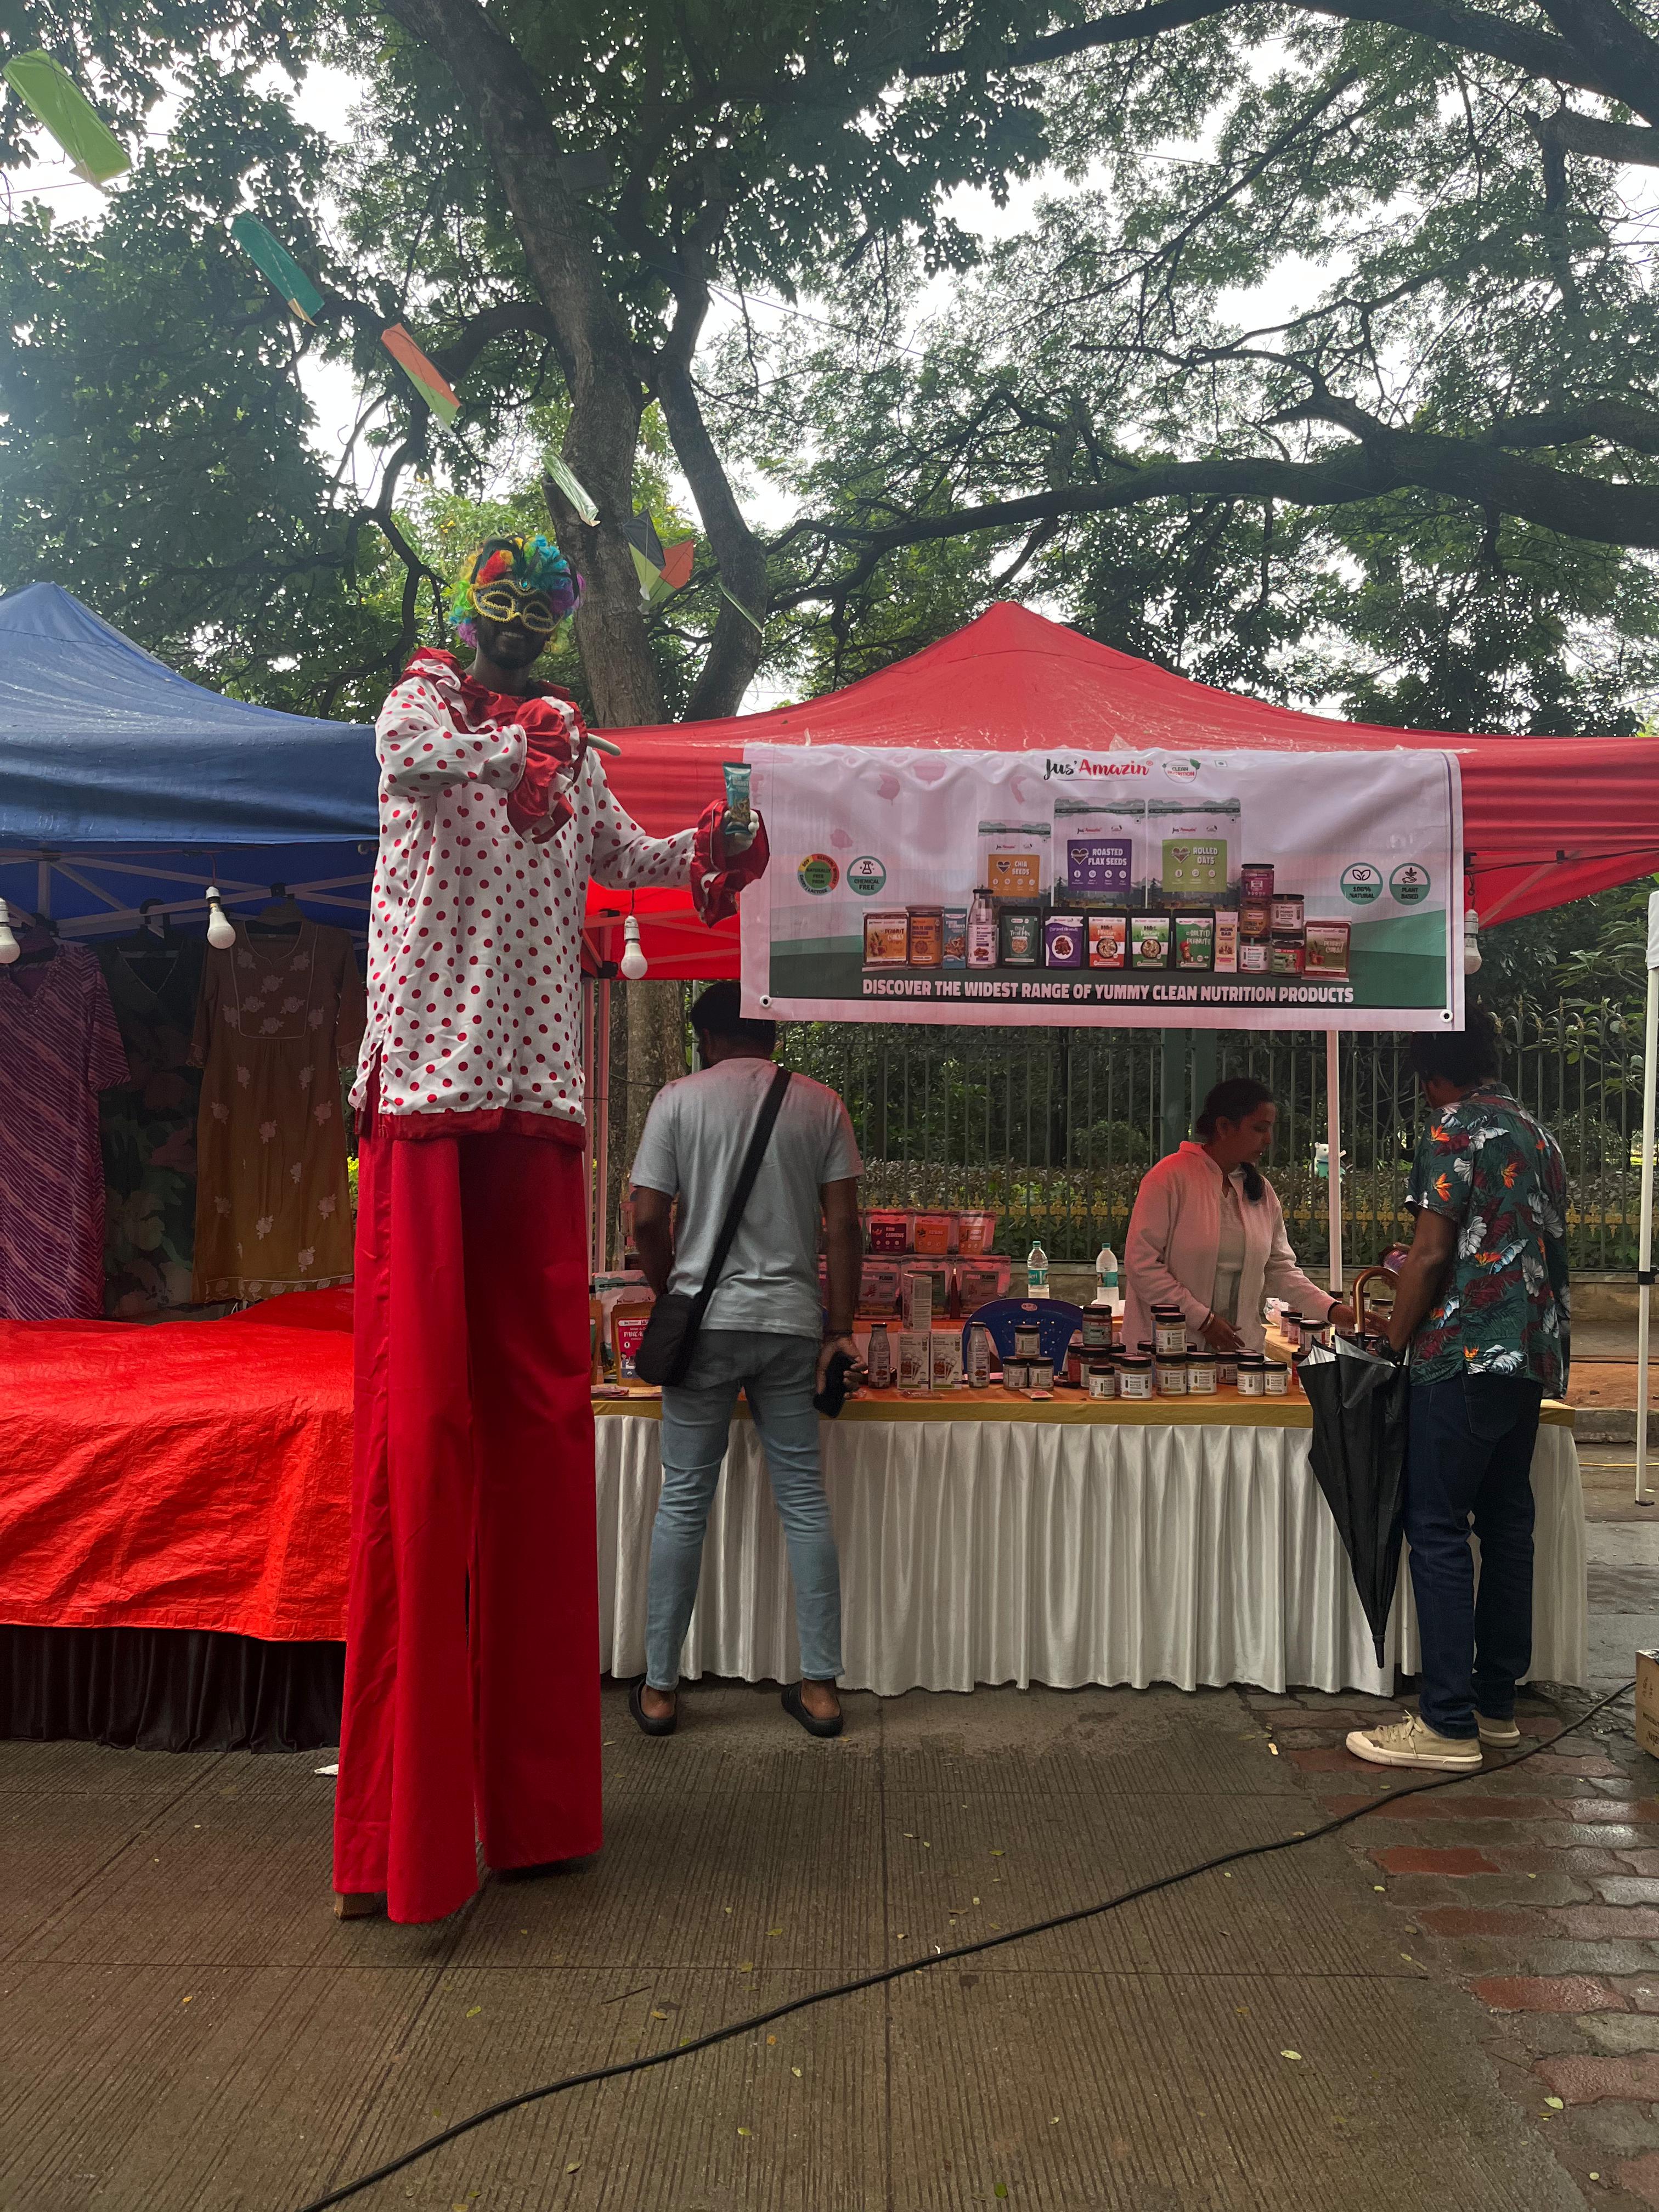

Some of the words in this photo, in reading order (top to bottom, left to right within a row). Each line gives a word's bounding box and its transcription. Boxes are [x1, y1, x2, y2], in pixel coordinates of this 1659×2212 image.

[1092, 848, 1124, 856] ROASTED
[1193, 847, 1218, 855] ROLLED
[1088, 857, 1105, 866] FLAX
[1105, 857, 1127, 866] SEEDS
[1197, 856, 1215, 865] OATS
[862, 979, 932, 996] DISCOVER
[934, 980, 961, 996] THE
[964, 981, 1019, 998] WIDEST
[1022, 983, 1070, 999] RANGE
[1075, 984, 1092, 999] OF
[1094, 984, 1150, 1000] YUMMY
[1152, 985, 1198, 1001] CLEAN
[1200, 986, 1277, 1002] NUTRITION
[1279, 987, 1354, 1003] PRODUCTS
